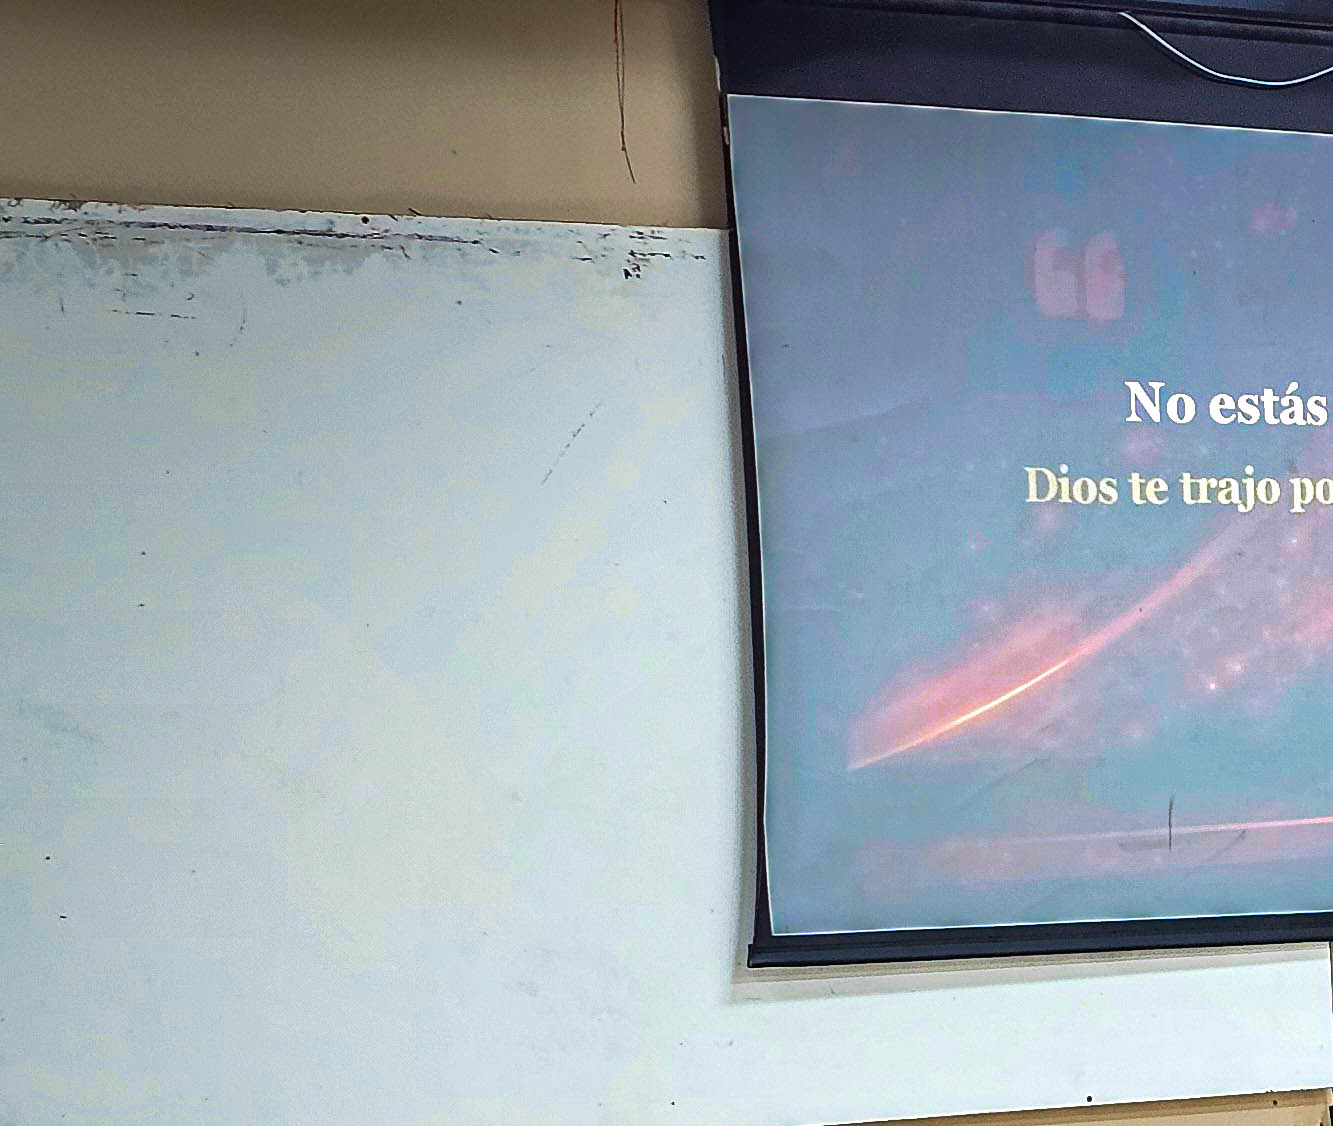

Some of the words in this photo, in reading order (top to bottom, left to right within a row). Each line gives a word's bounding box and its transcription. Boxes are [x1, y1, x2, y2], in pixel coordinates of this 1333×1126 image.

[1124, 381, 1196, 424] No
[1208, 381, 1328, 427] estás
[1023, 463, 1119, 505] Dios
[1127, 471, 1170, 506] te
[1178, 464, 1281, 513] trajo
